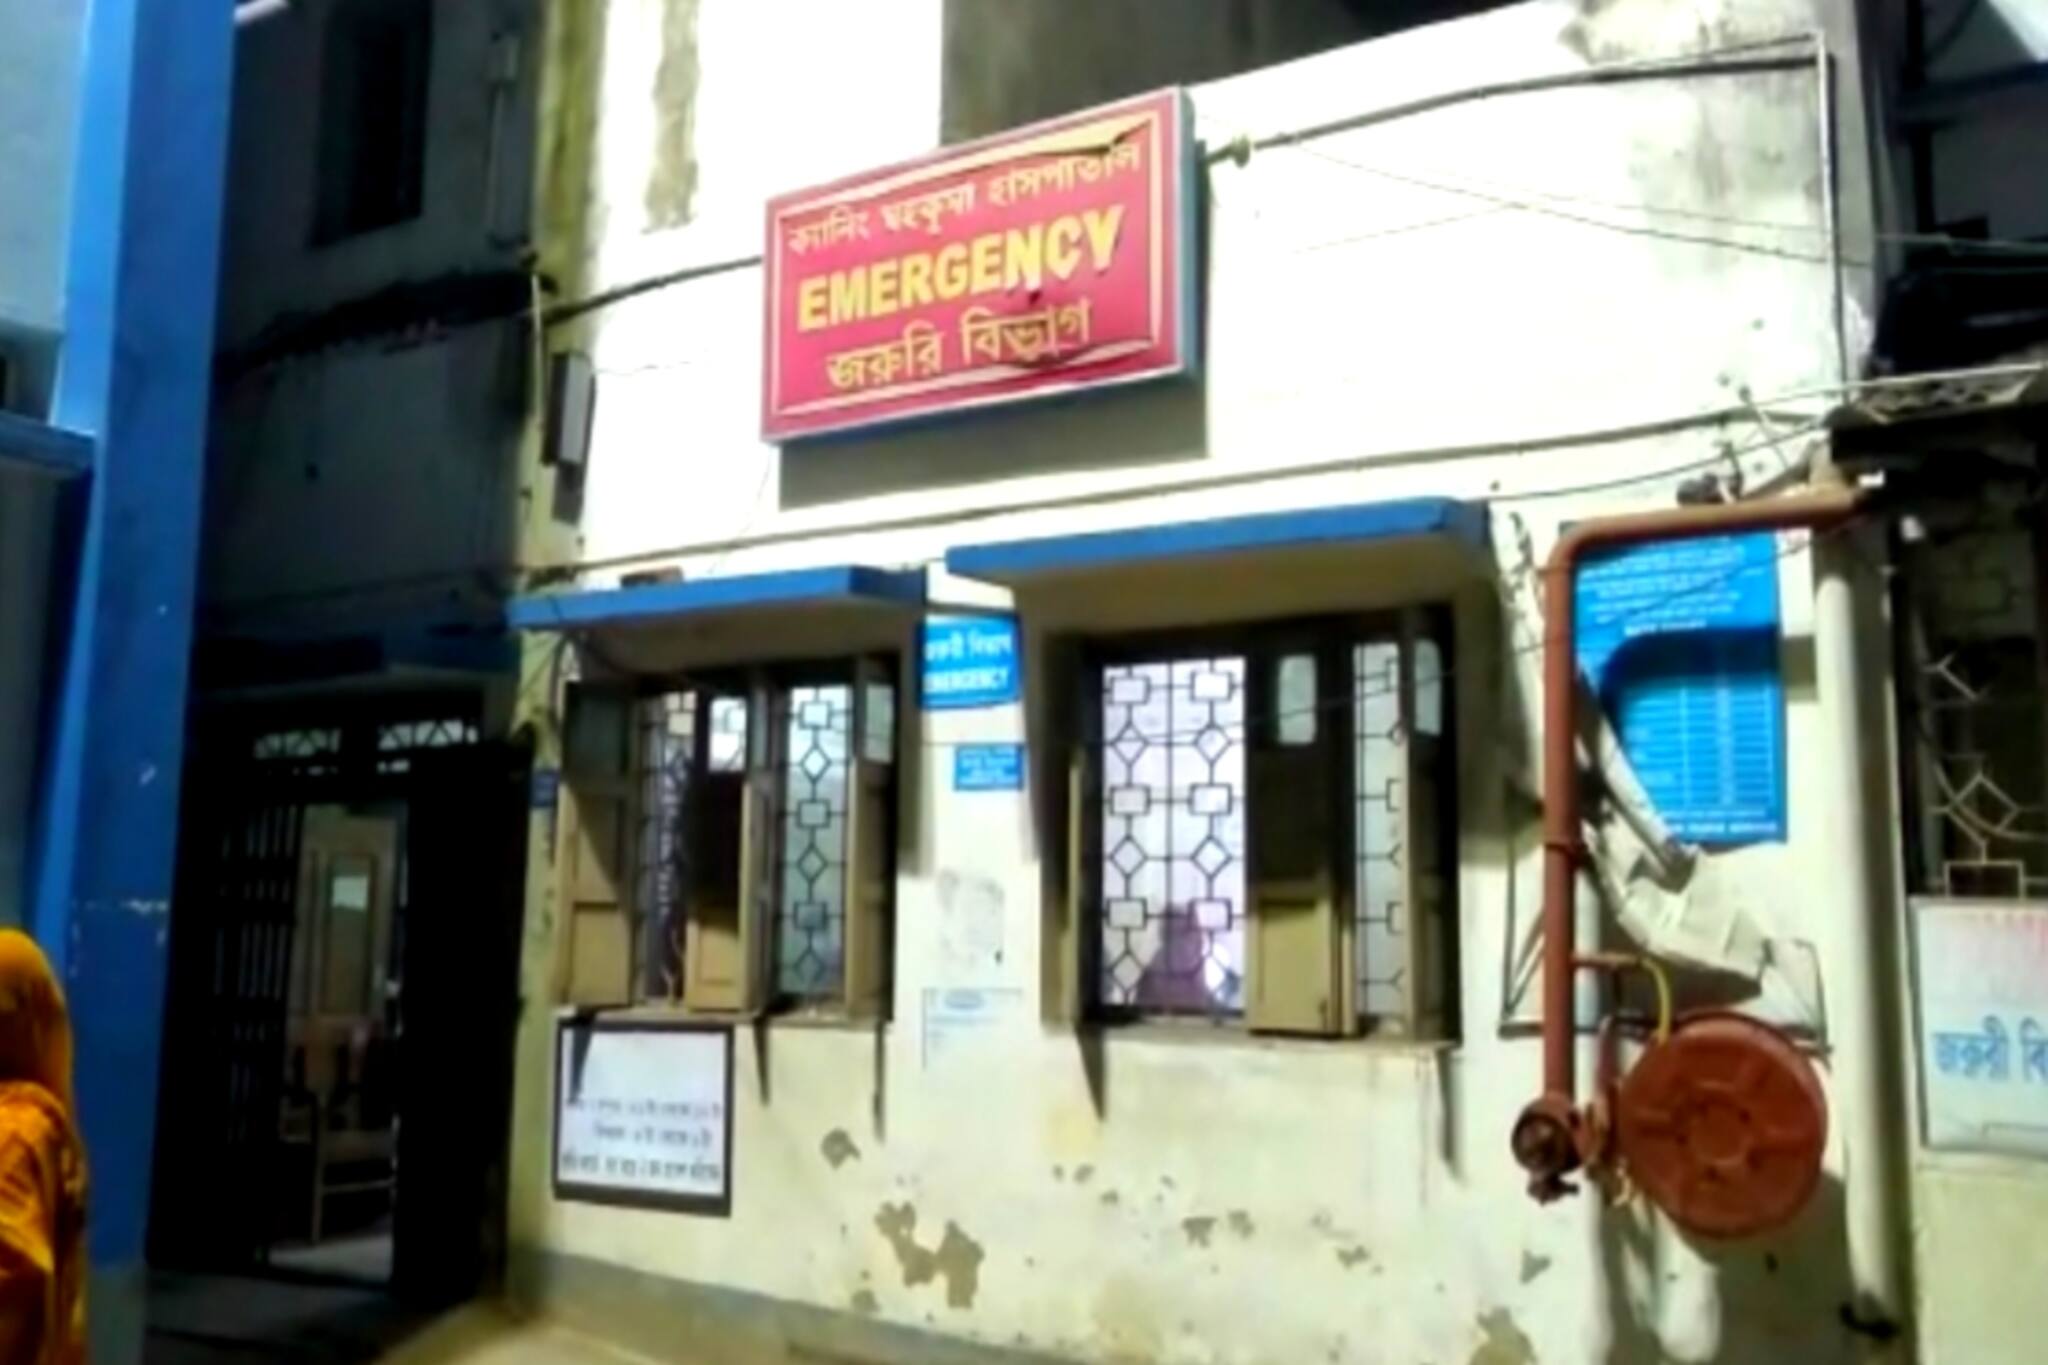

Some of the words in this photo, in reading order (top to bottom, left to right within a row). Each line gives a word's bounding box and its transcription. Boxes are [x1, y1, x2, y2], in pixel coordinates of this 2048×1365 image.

[797, 204, 1125, 333] EMERGENCY
[826, 320, 945, 390] জরুরি
[961, 294, 1092, 366] বিভাগ
